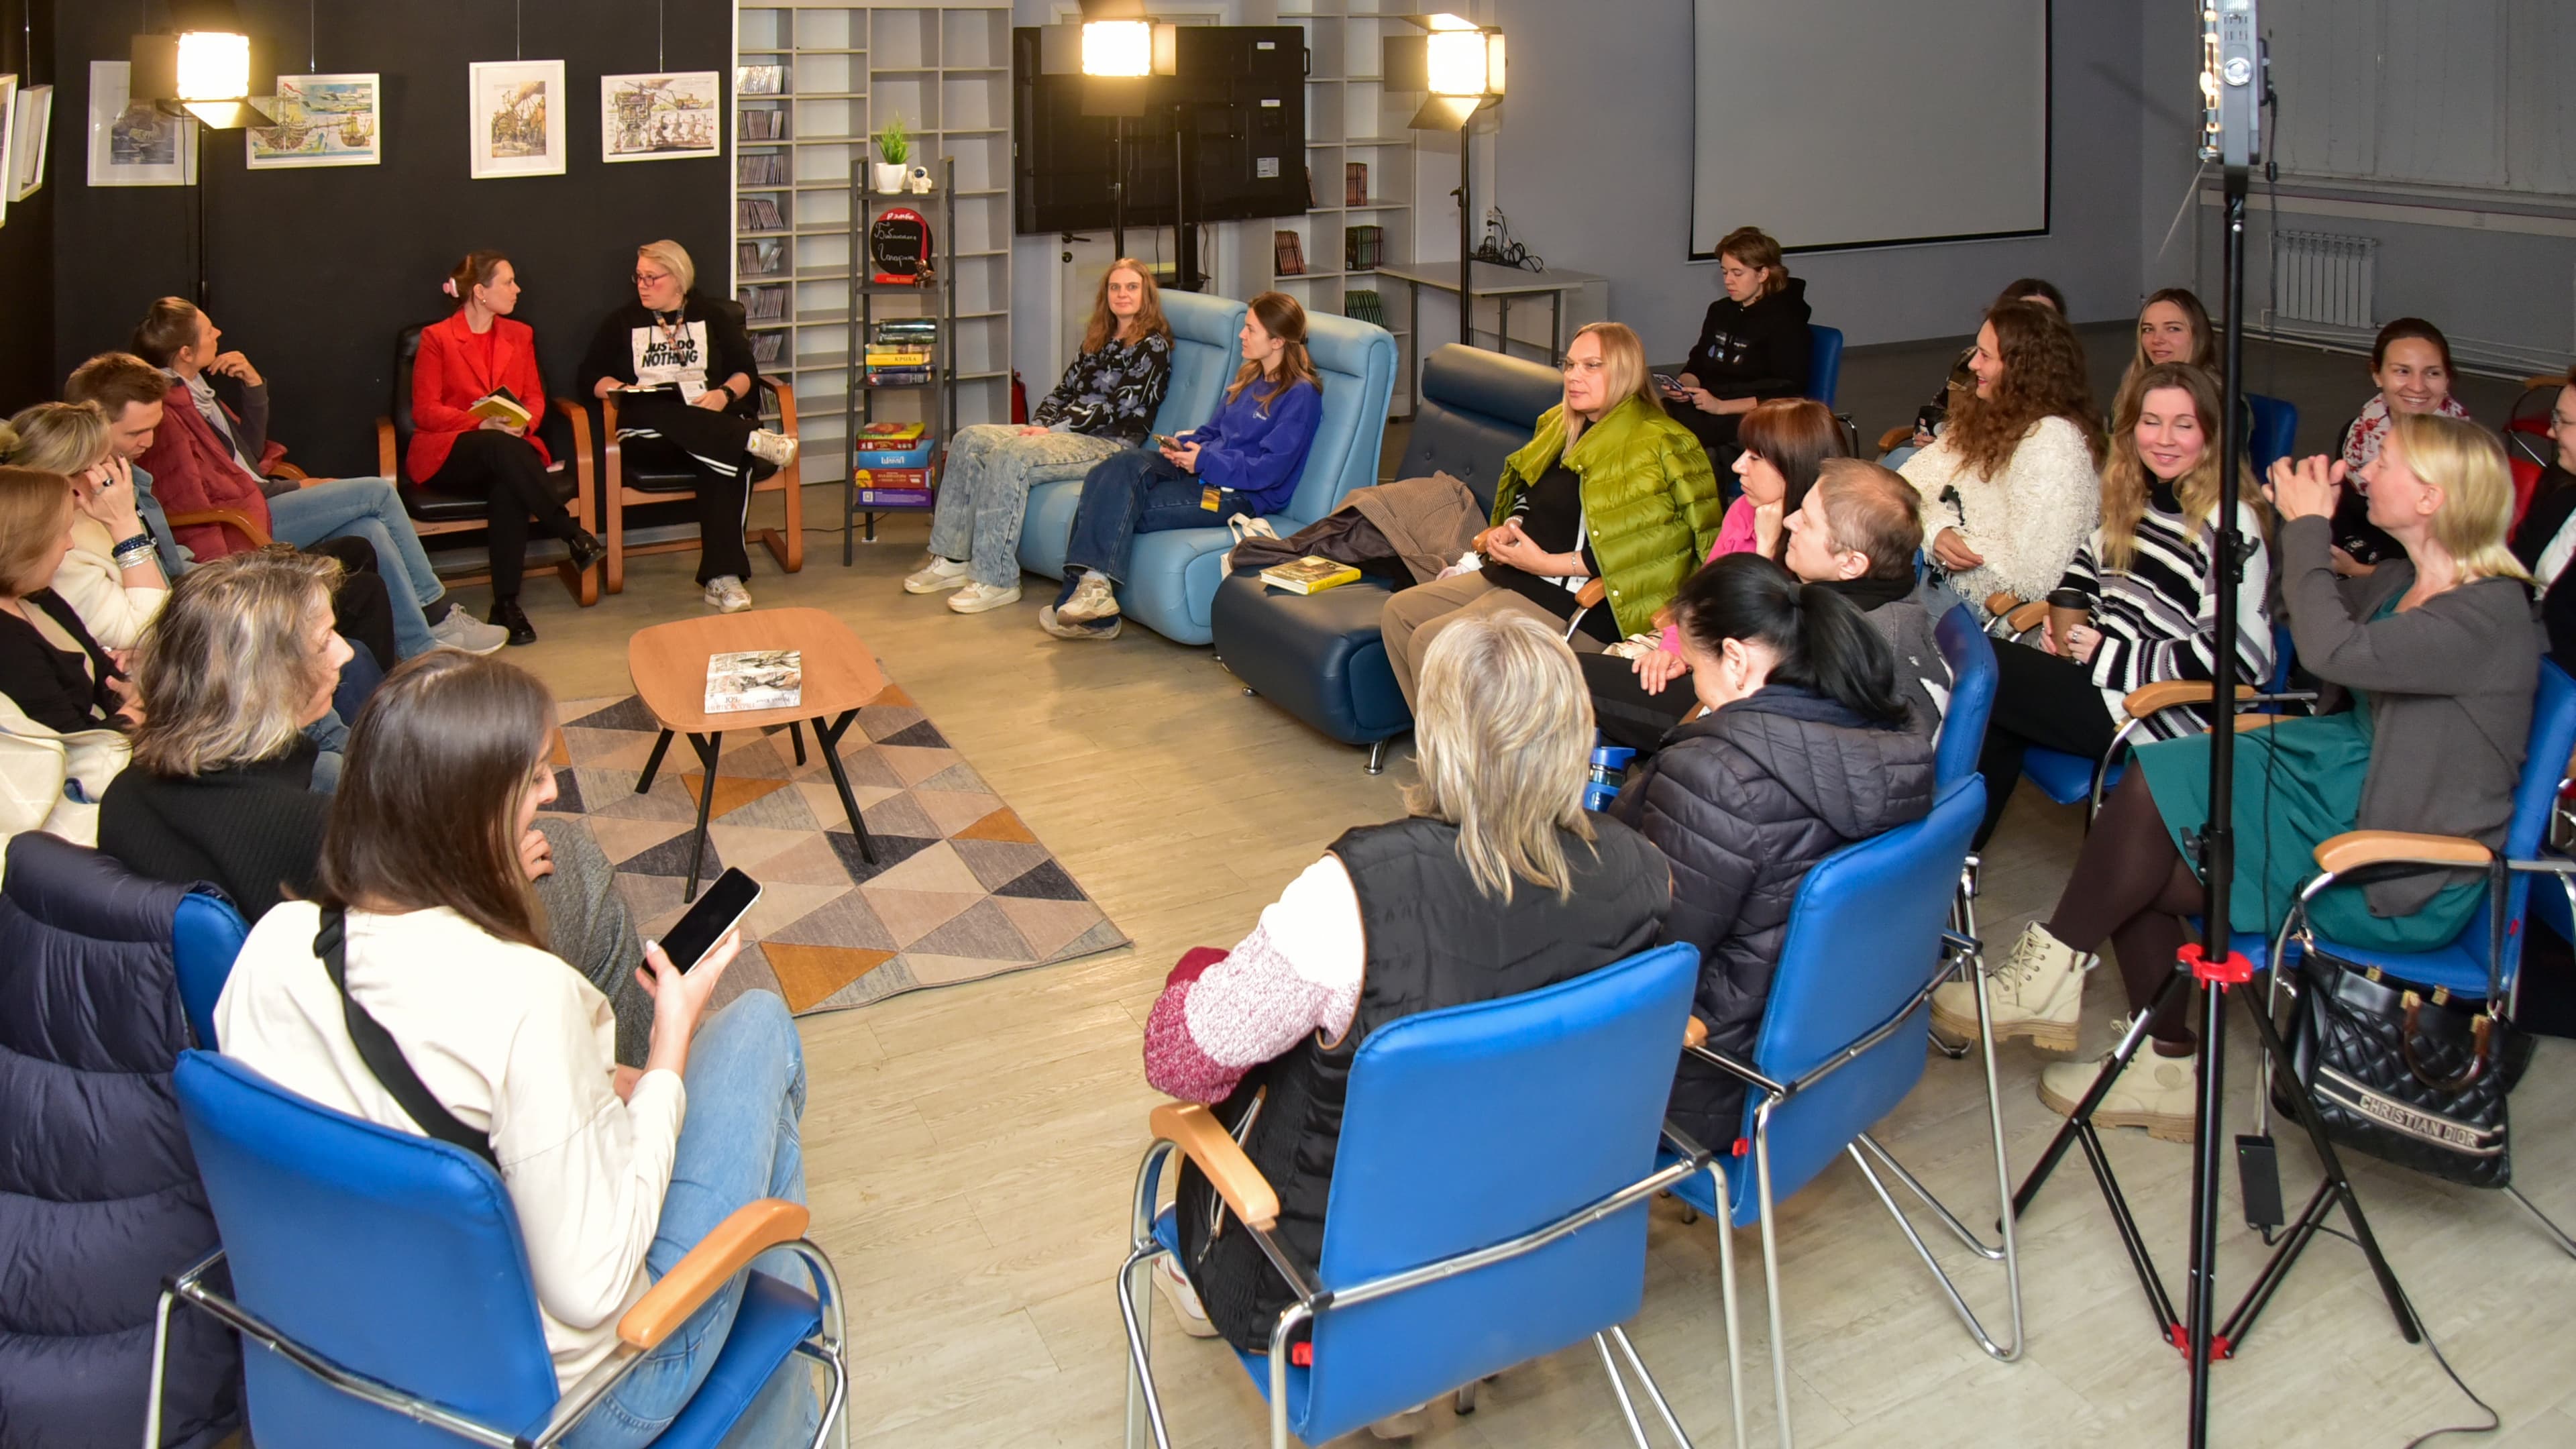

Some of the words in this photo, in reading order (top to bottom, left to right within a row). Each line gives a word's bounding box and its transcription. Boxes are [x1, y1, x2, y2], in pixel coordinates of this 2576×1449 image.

[677, 339, 695, 350] DO
[642, 350, 698, 368] NOTHNG
[2359, 1094, 2440, 1136] CHRISTIAN
[2443, 1125, 2477, 1148] DIOR
